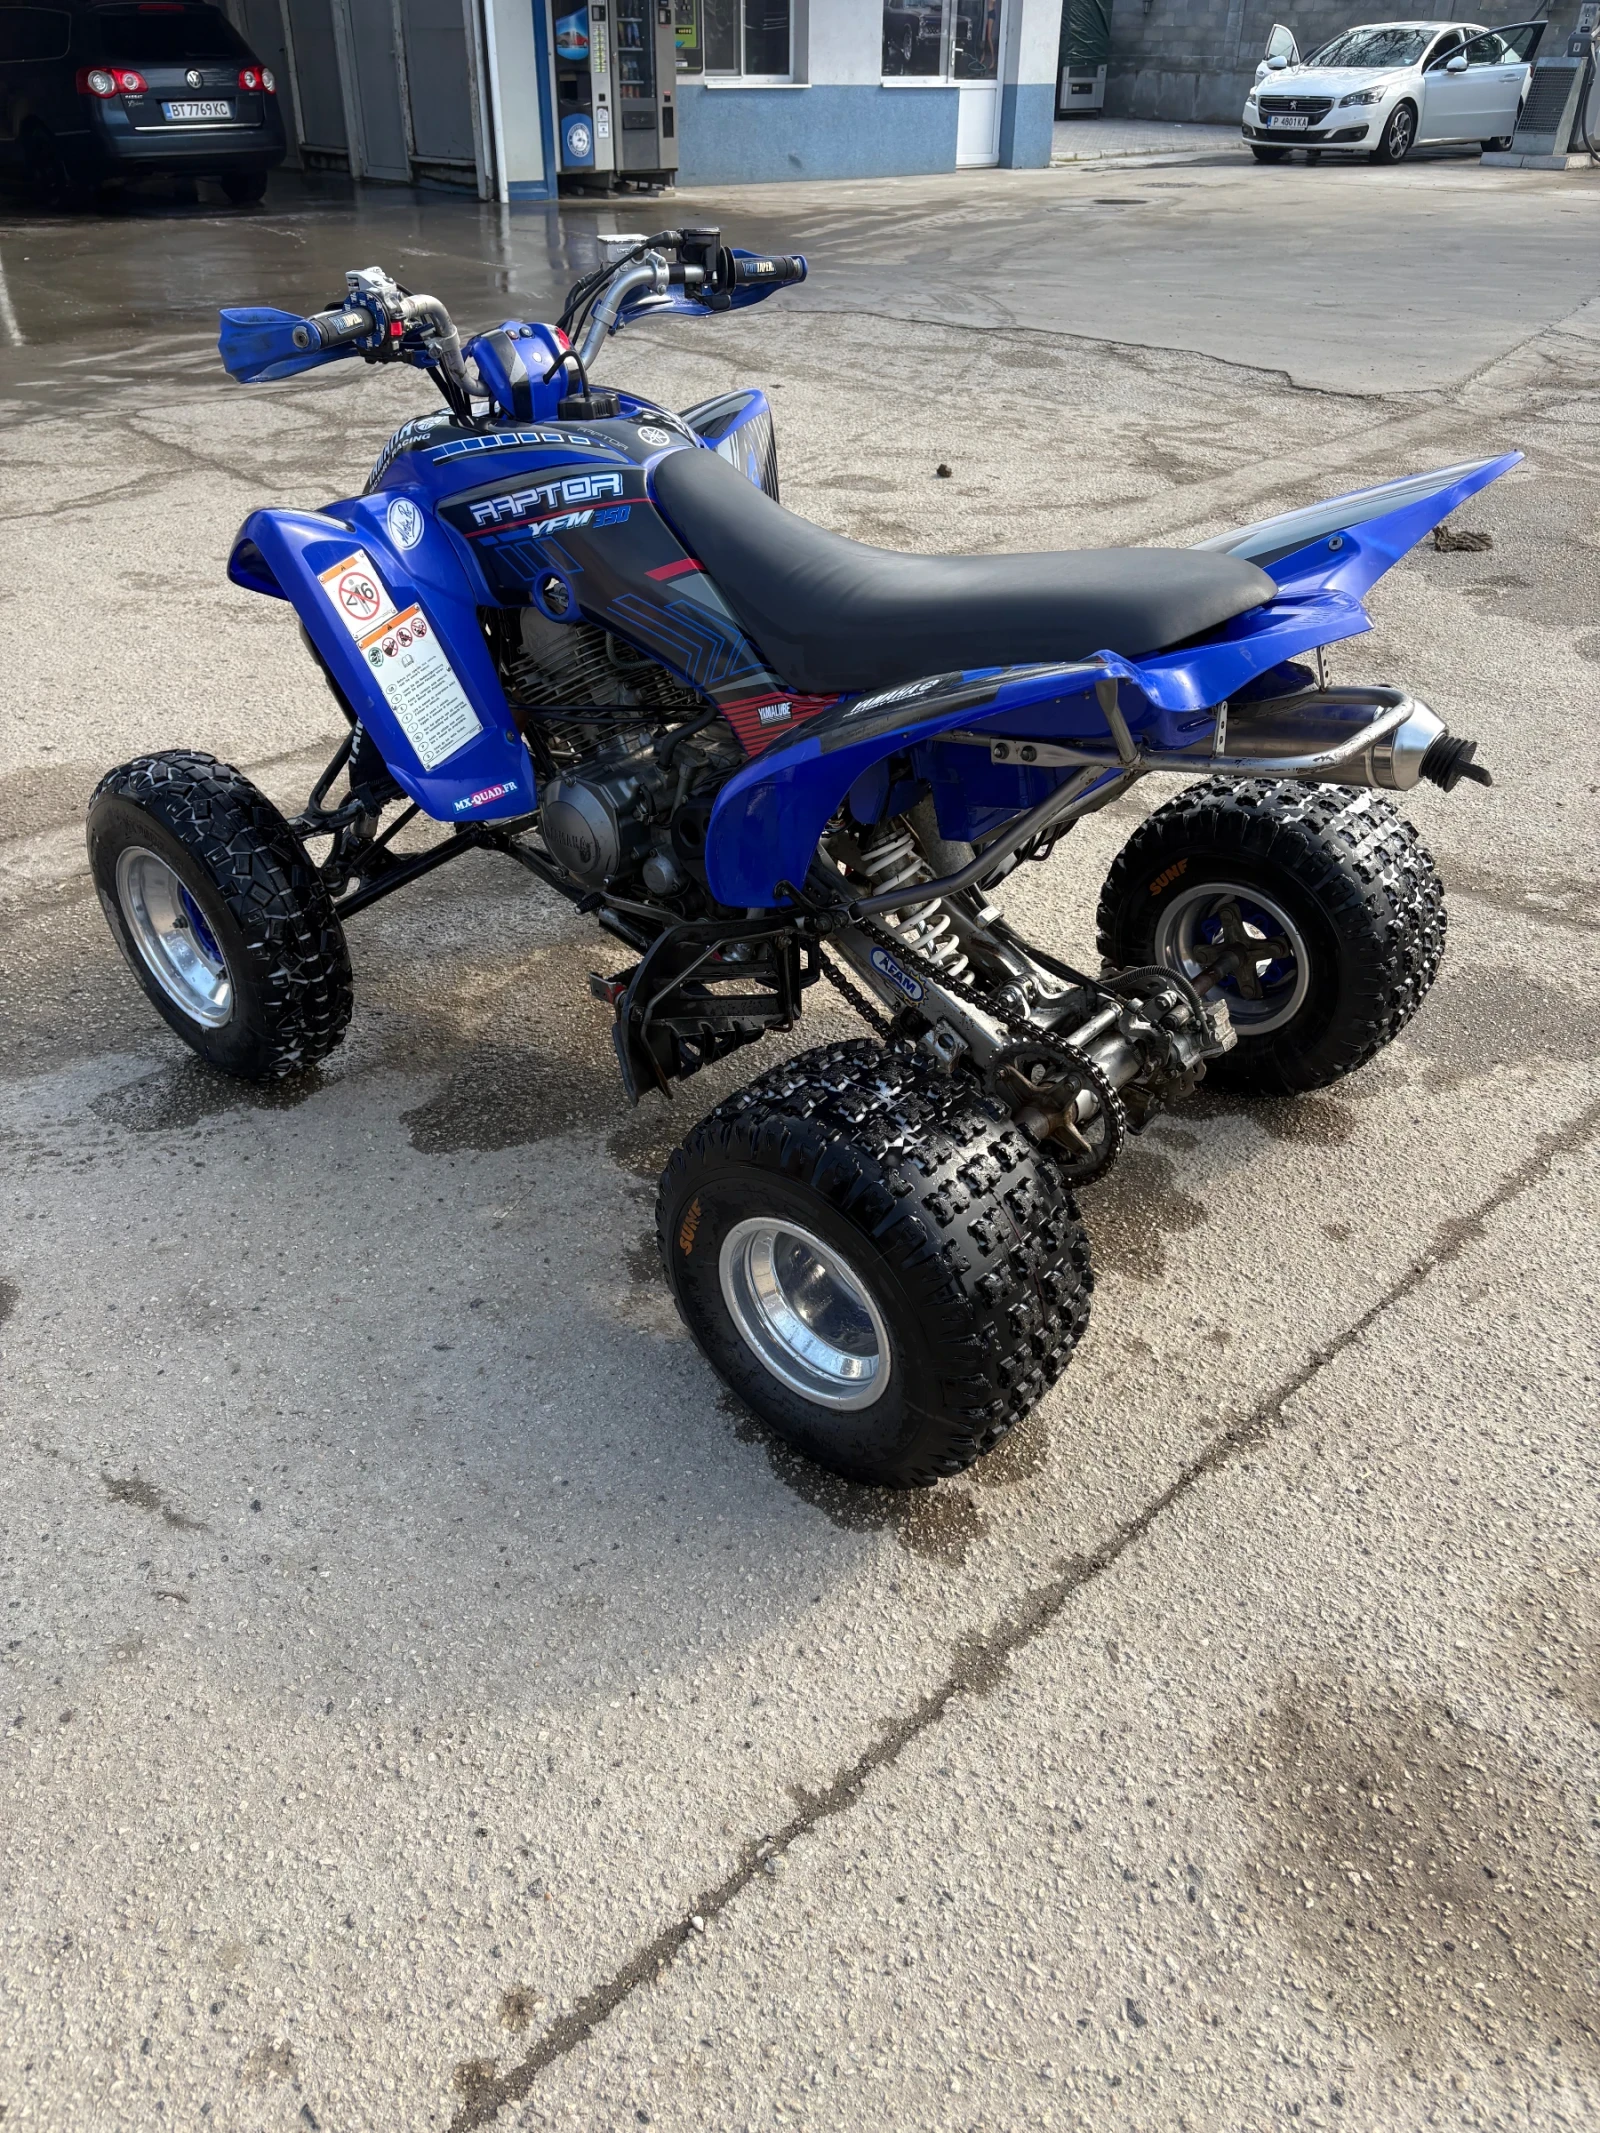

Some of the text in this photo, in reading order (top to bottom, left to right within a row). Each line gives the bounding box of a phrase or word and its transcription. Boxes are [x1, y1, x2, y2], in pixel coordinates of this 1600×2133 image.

[391, 432, 431, 458] RACING
[469, 472, 624, 526] RAPTOR
[528, 505, 632, 538] YFM 350
[758, 702, 792, 721] YAMALUBE
[453, 781, 518, 812] MX-QUAD.FR
[1149, 857, 1188, 896] SUNF
[879, 956, 917, 994] AFAM
[679, 1196, 702, 1257] SUNF
